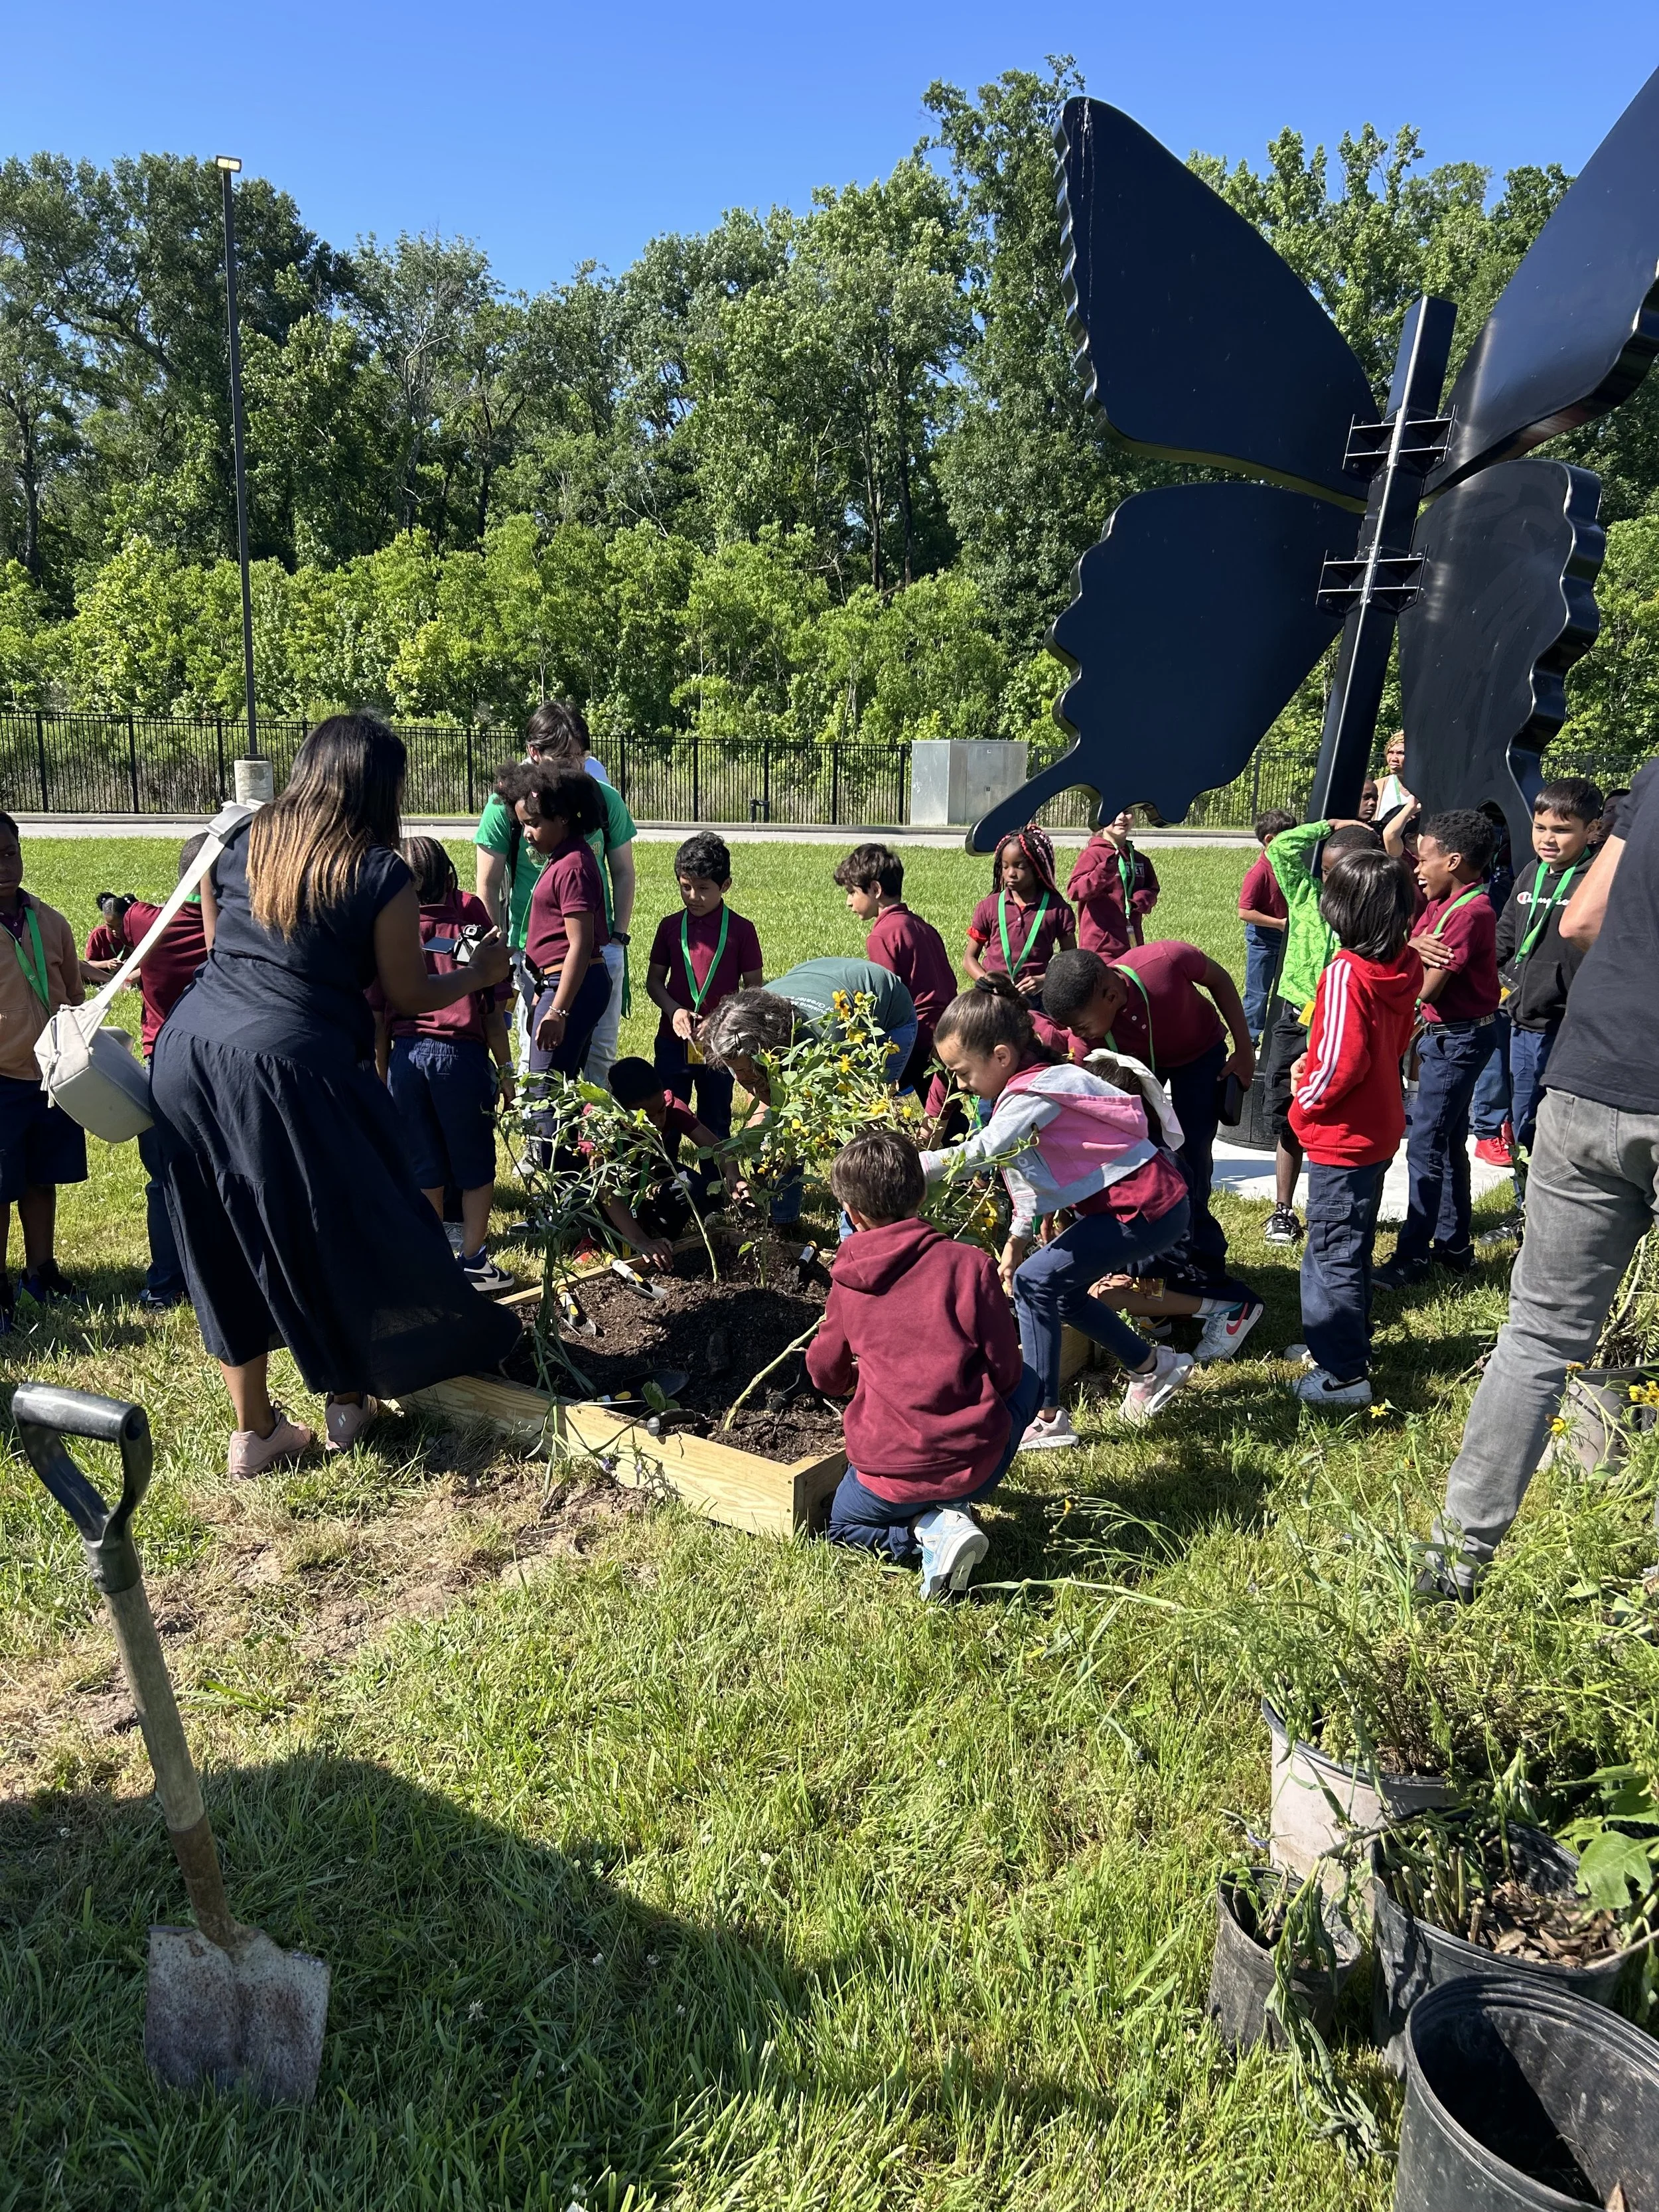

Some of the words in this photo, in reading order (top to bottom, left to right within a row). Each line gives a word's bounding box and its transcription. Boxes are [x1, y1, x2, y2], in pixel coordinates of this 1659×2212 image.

[1517, 891, 1570, 909] Chmpio
[795, 996, 826, 1008] Greater
[799, 1001, 828, 1015] ouisiana
